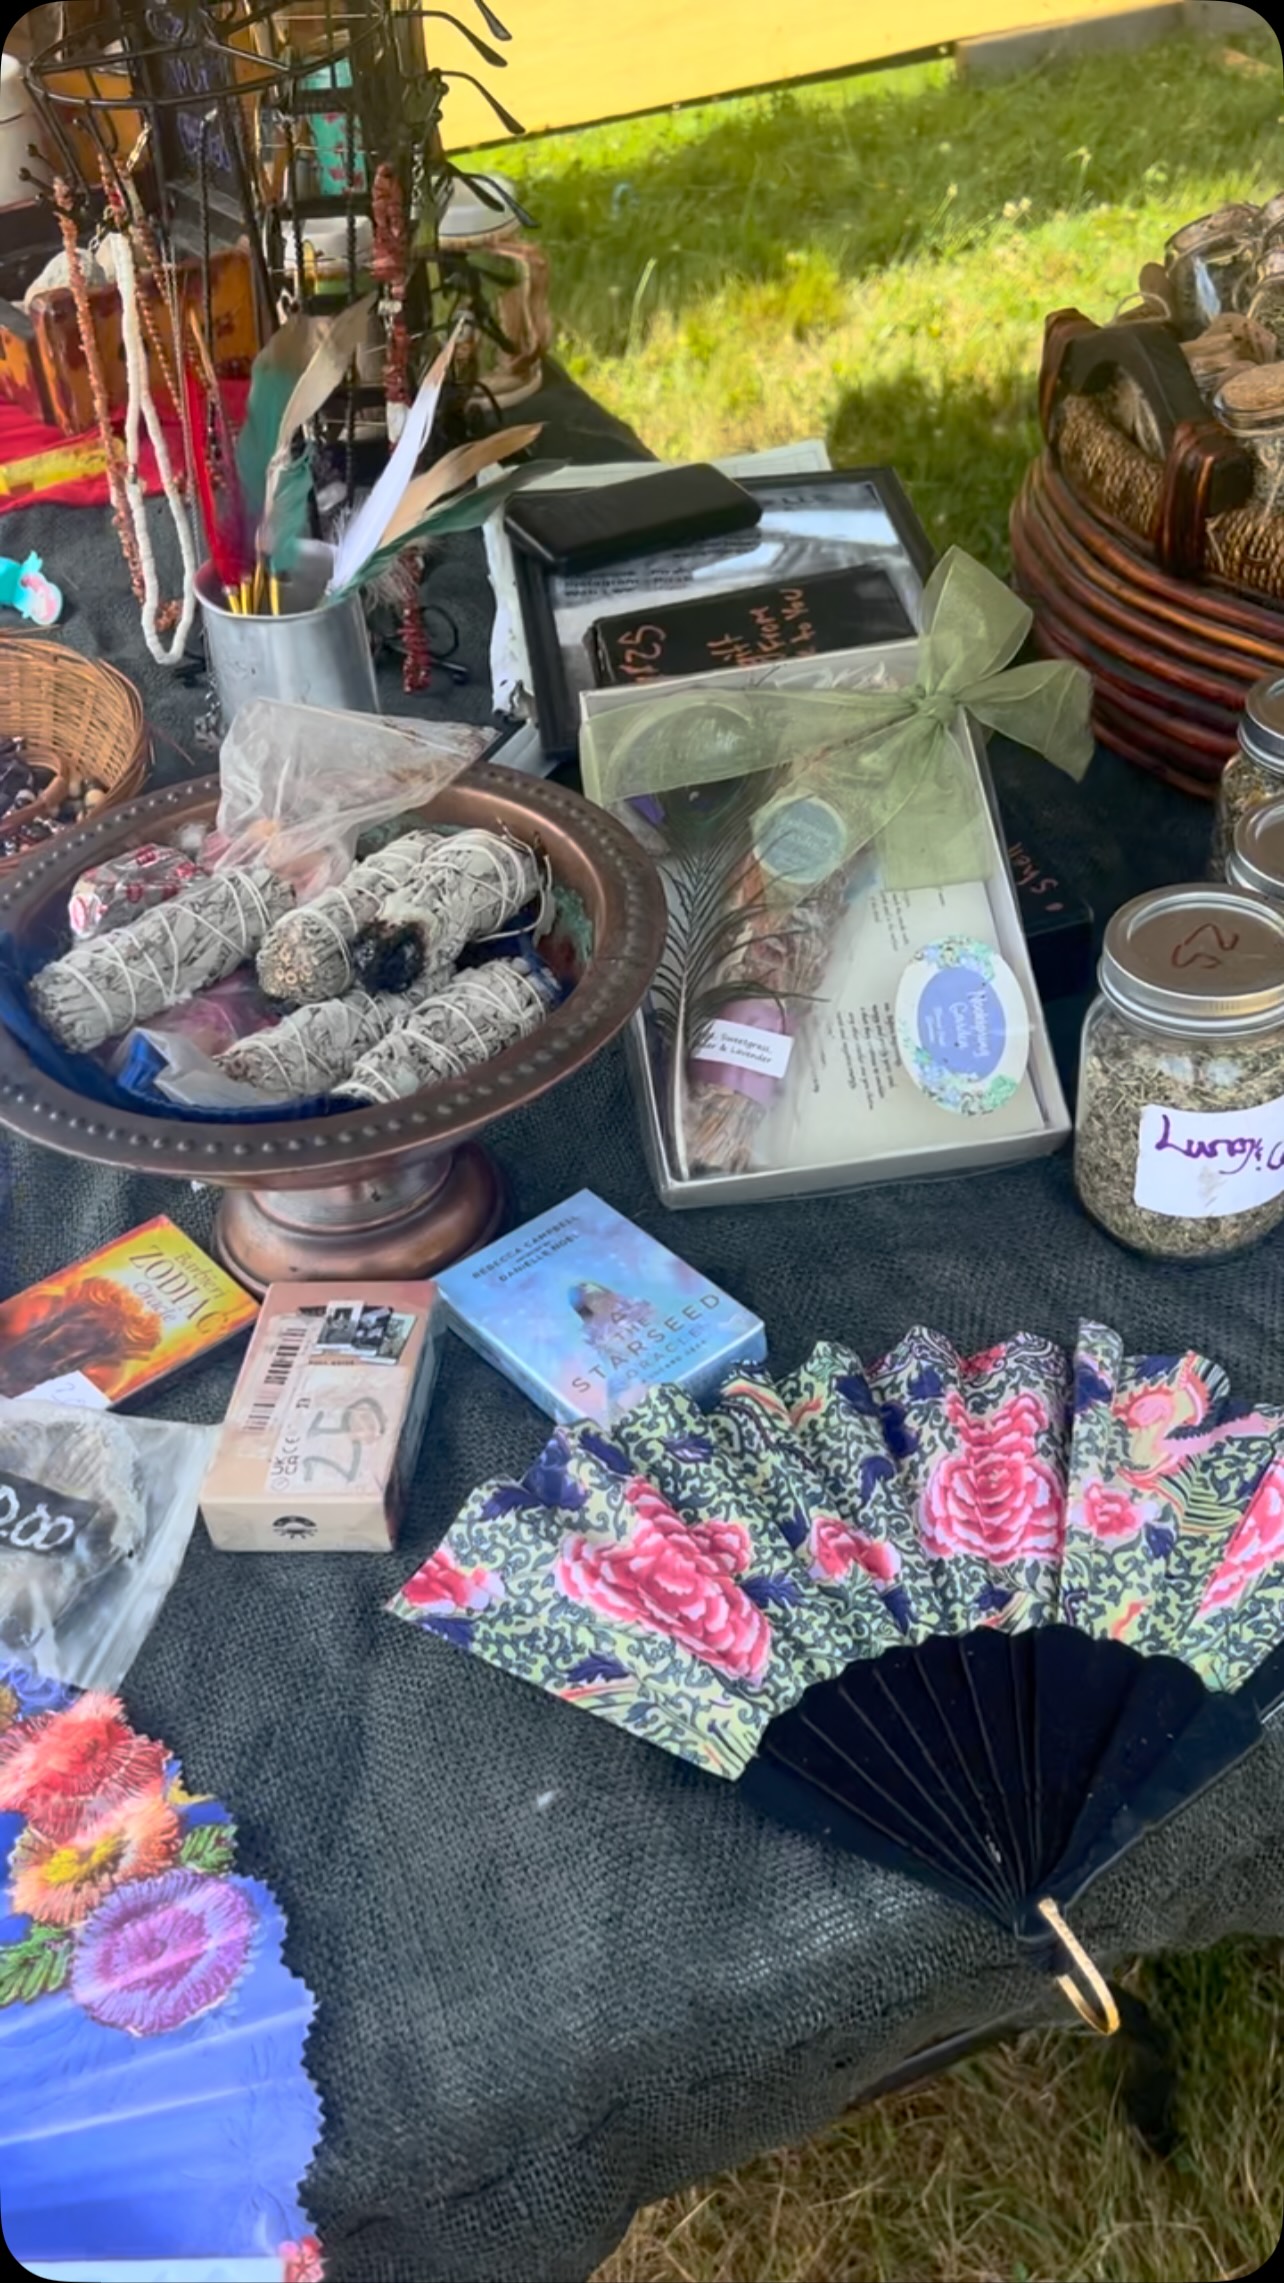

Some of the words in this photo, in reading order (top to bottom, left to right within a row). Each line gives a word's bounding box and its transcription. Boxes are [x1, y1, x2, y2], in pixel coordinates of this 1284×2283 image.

[472, 1247, 522, 1279] REBECCA
[524, 1215, 580, 1248] CAMPBELL
[129, 1244, 229, 1335] ZODIAC
[571, 1293, 721, 1394] STARSEED
[613, 1316, 650, 1341] THE
[625, 1325, 703, 1380] ORACLE
[303, 1396, 388, 1483] 25
